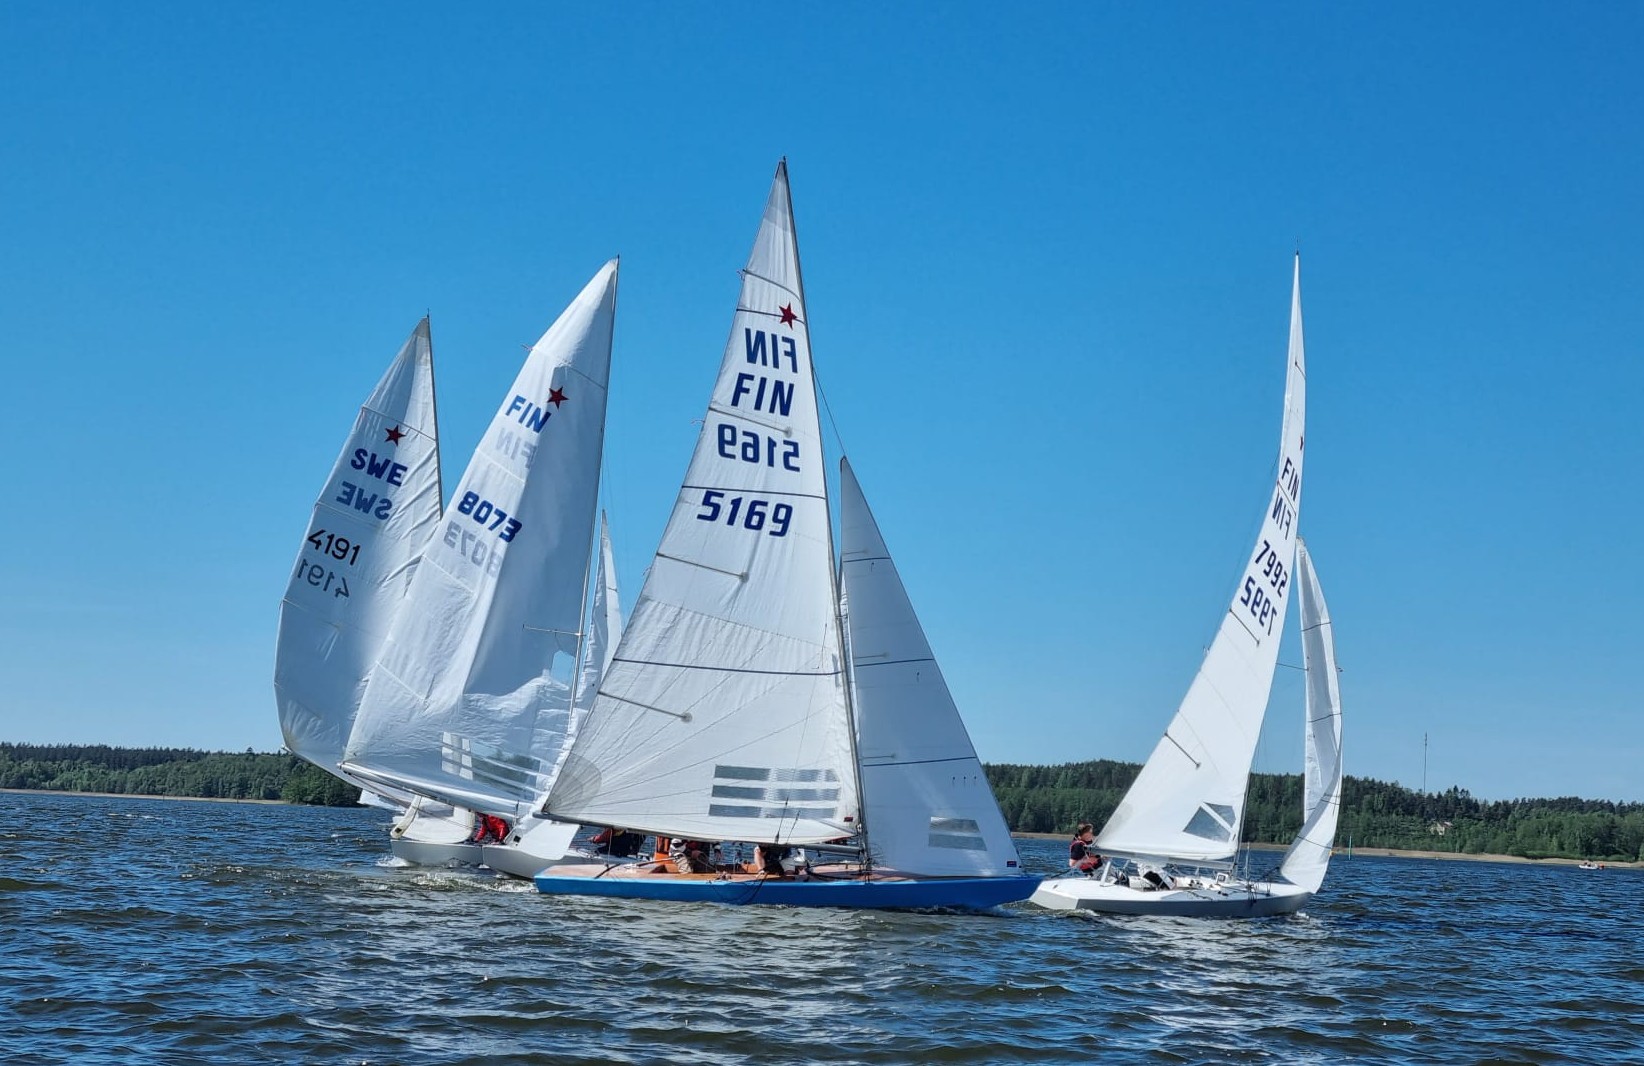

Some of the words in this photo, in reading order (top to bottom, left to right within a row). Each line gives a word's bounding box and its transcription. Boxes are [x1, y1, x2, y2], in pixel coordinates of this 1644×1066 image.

[505, 395, 552, 434] FIN
[731, 372, 795, 417] FIN
[351, 448, 408, 487] SWE
[1281, 457, 1300, 502] FIN
[457, 490, 523, 543] 8073
[697, 490, 793, 537] 5169
[308, 529, 361, 566] 4191
[1254, 540, 1289, 598] 7992
